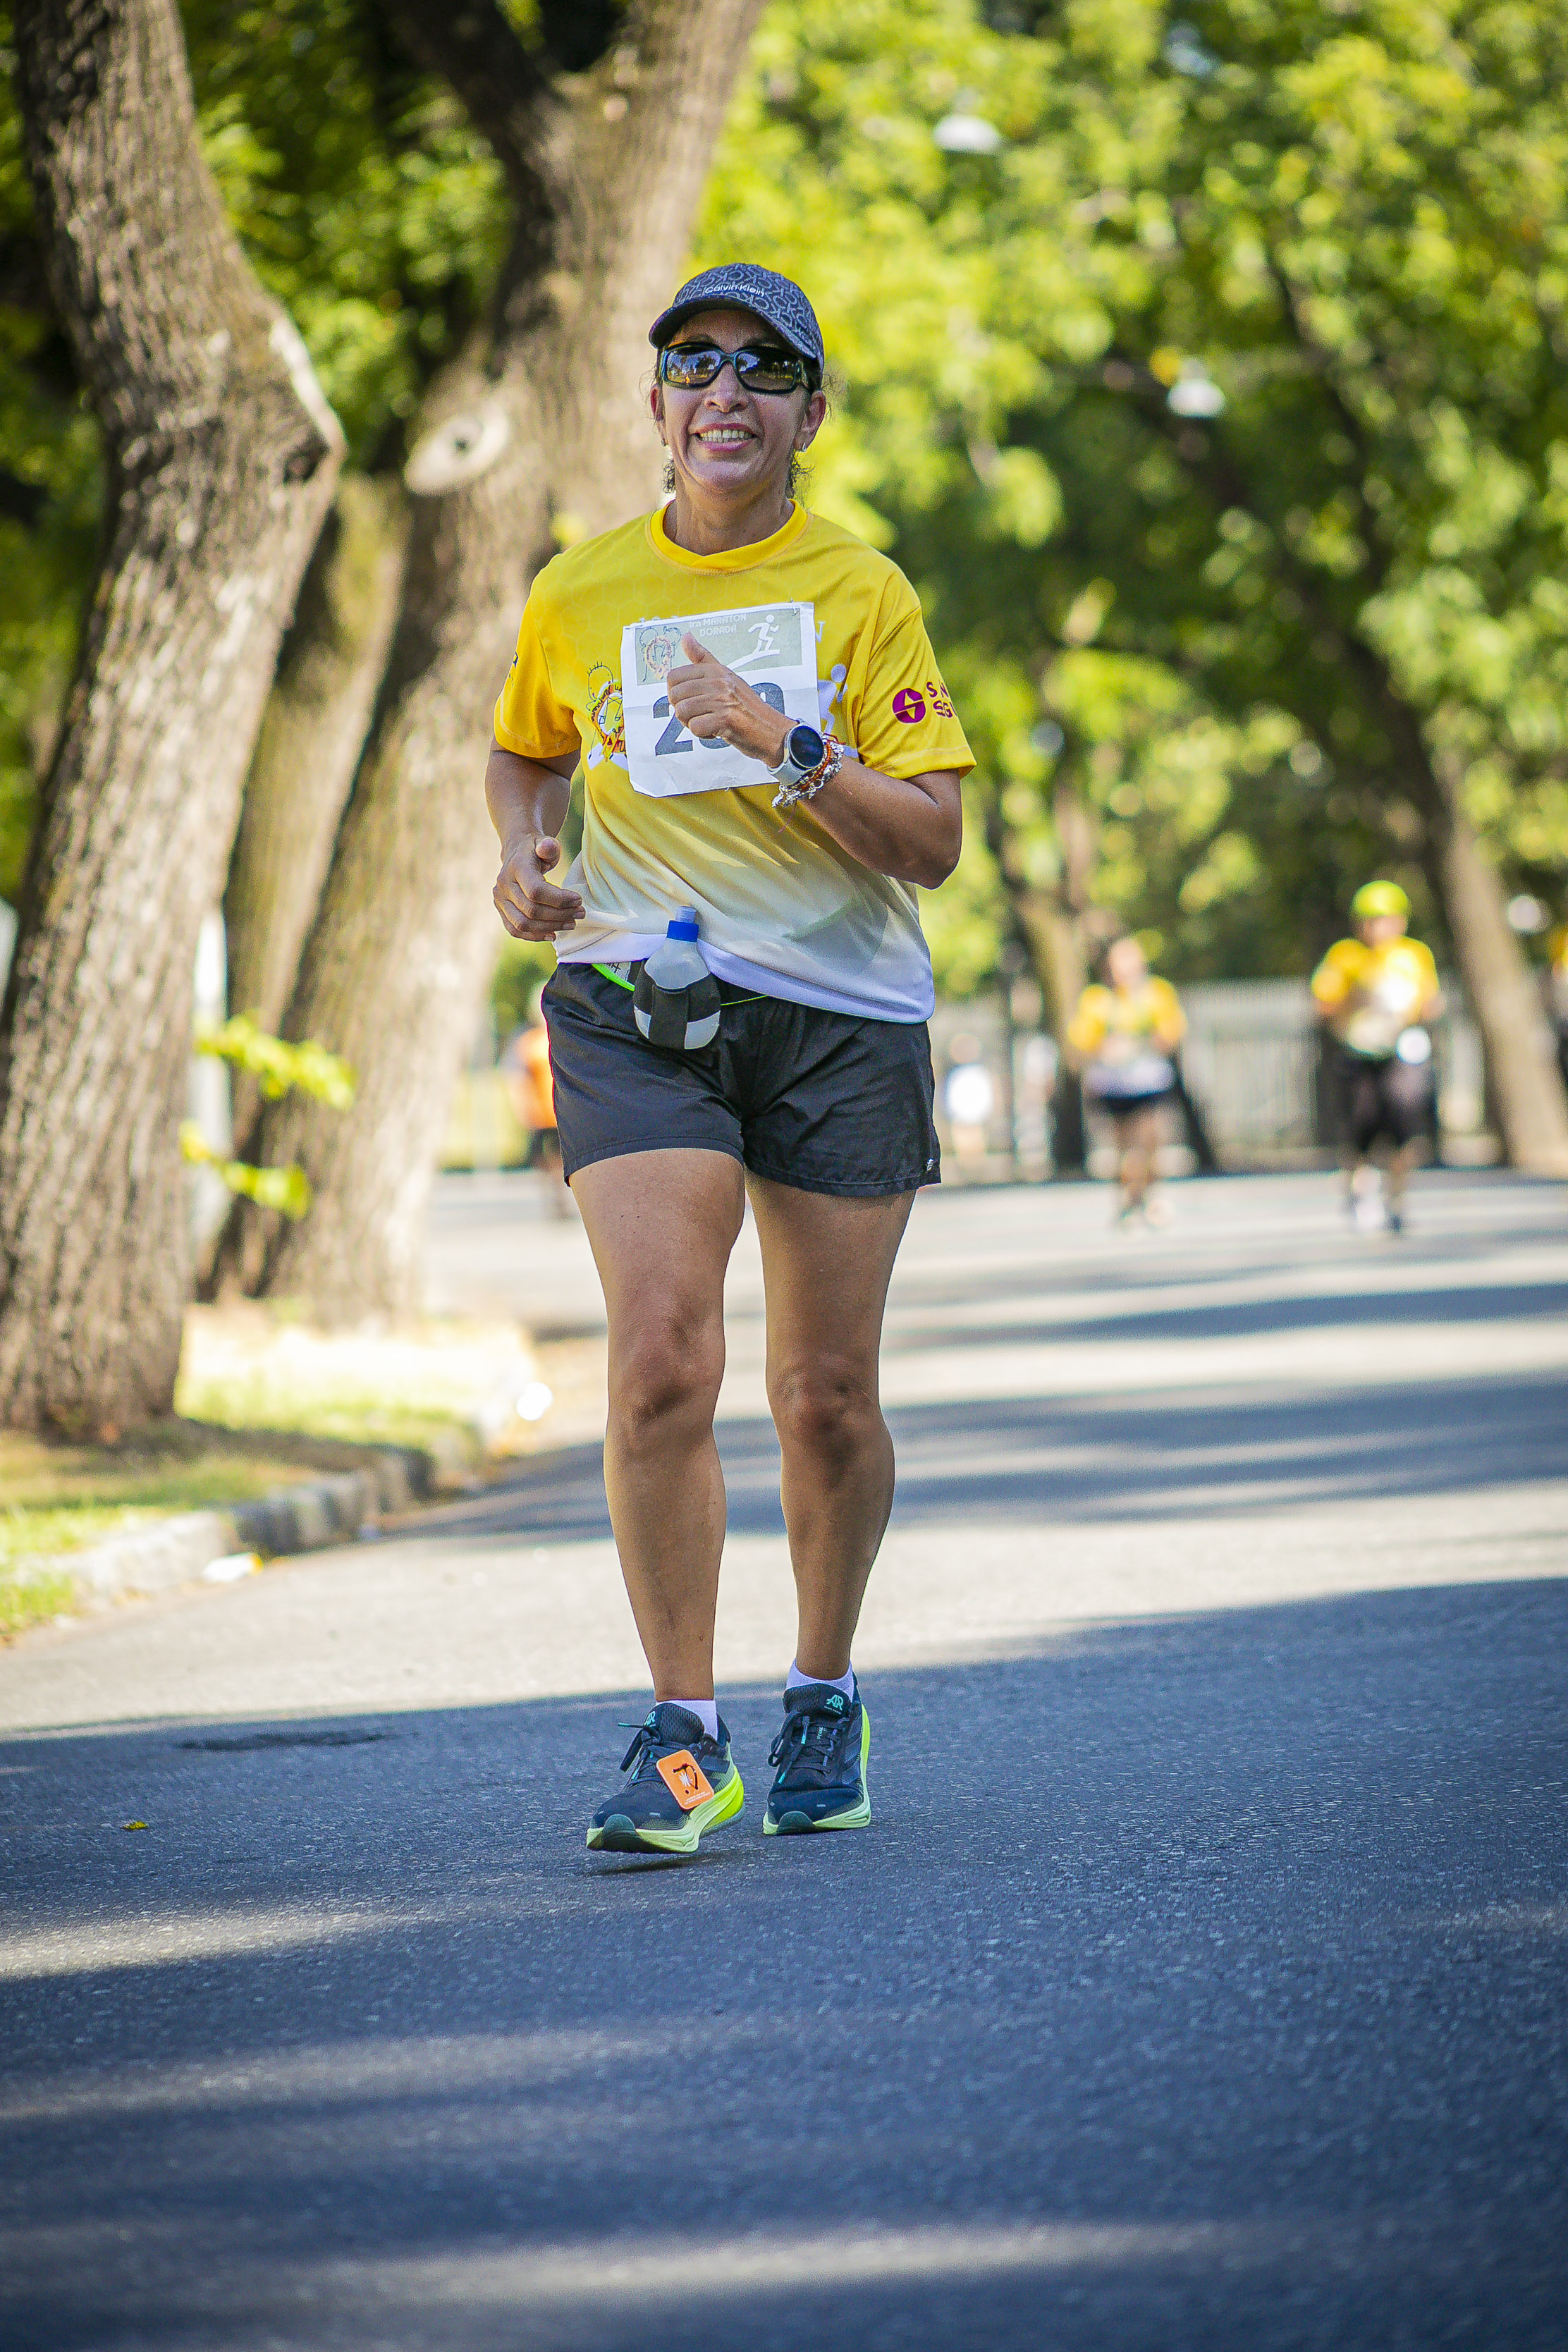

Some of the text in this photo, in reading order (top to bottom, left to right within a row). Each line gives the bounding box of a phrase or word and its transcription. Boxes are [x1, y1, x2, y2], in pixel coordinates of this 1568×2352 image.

[705, 283, 765, 297] Calvin Klein
[700, 625, 736, 637] DORADA
[926, 682, 949, 698] SN
